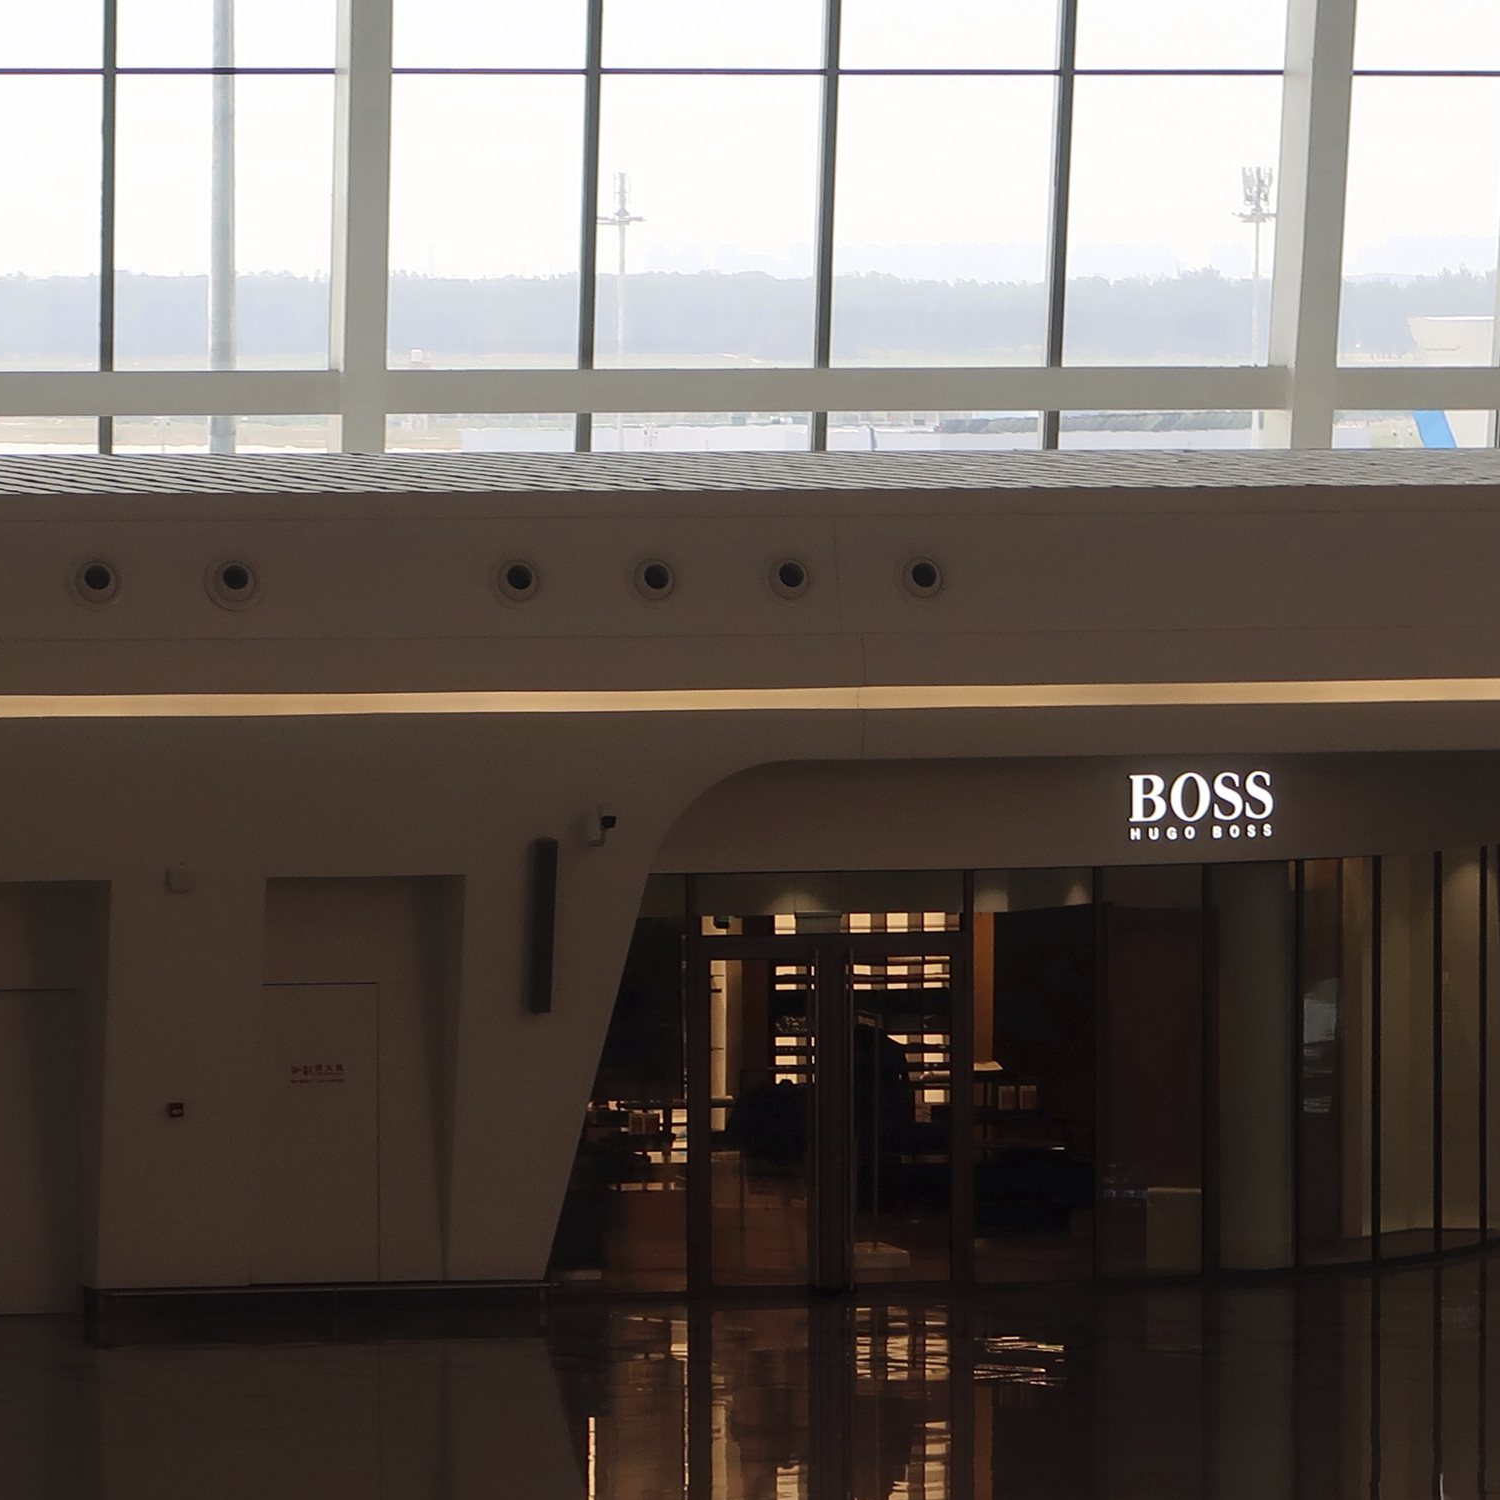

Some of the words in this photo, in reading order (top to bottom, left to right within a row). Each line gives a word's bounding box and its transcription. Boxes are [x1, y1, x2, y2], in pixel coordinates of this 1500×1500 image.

[1128, 770, 1275, 824] BOSS
[1129, 825, 1197, 841] HUGO
[1211, 823, 1274, 839] BOSS
